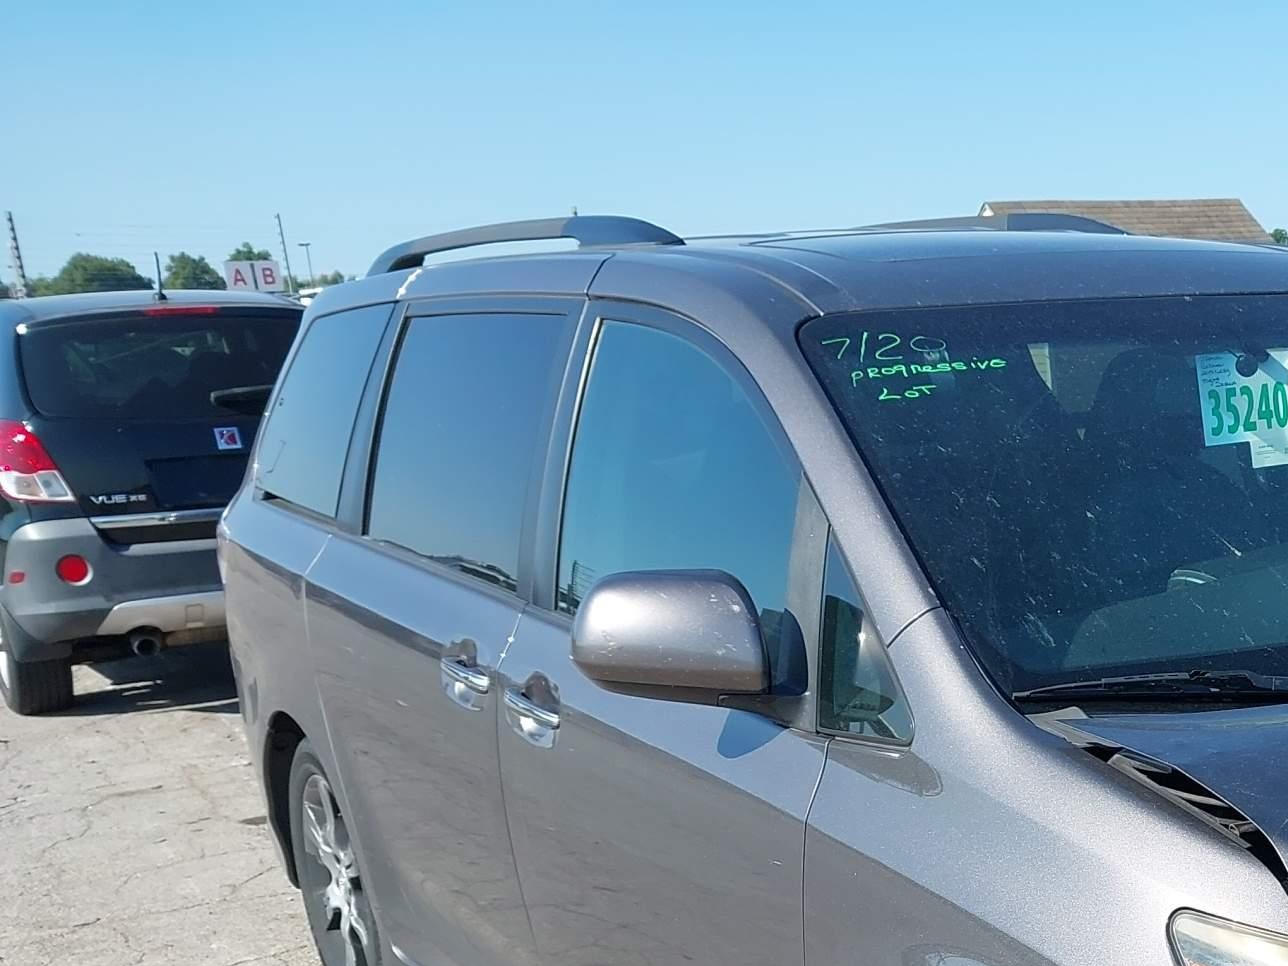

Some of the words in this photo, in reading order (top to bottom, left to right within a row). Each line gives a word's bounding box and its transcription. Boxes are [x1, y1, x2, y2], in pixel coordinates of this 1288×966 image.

[233, 267, 248, 286] A
[261, 267, 276, 285] B
[821, 331, 947, 362] 7/20
[1207, 381, 1288, 437] 35240
[89, 494, 128, 504] VUE
